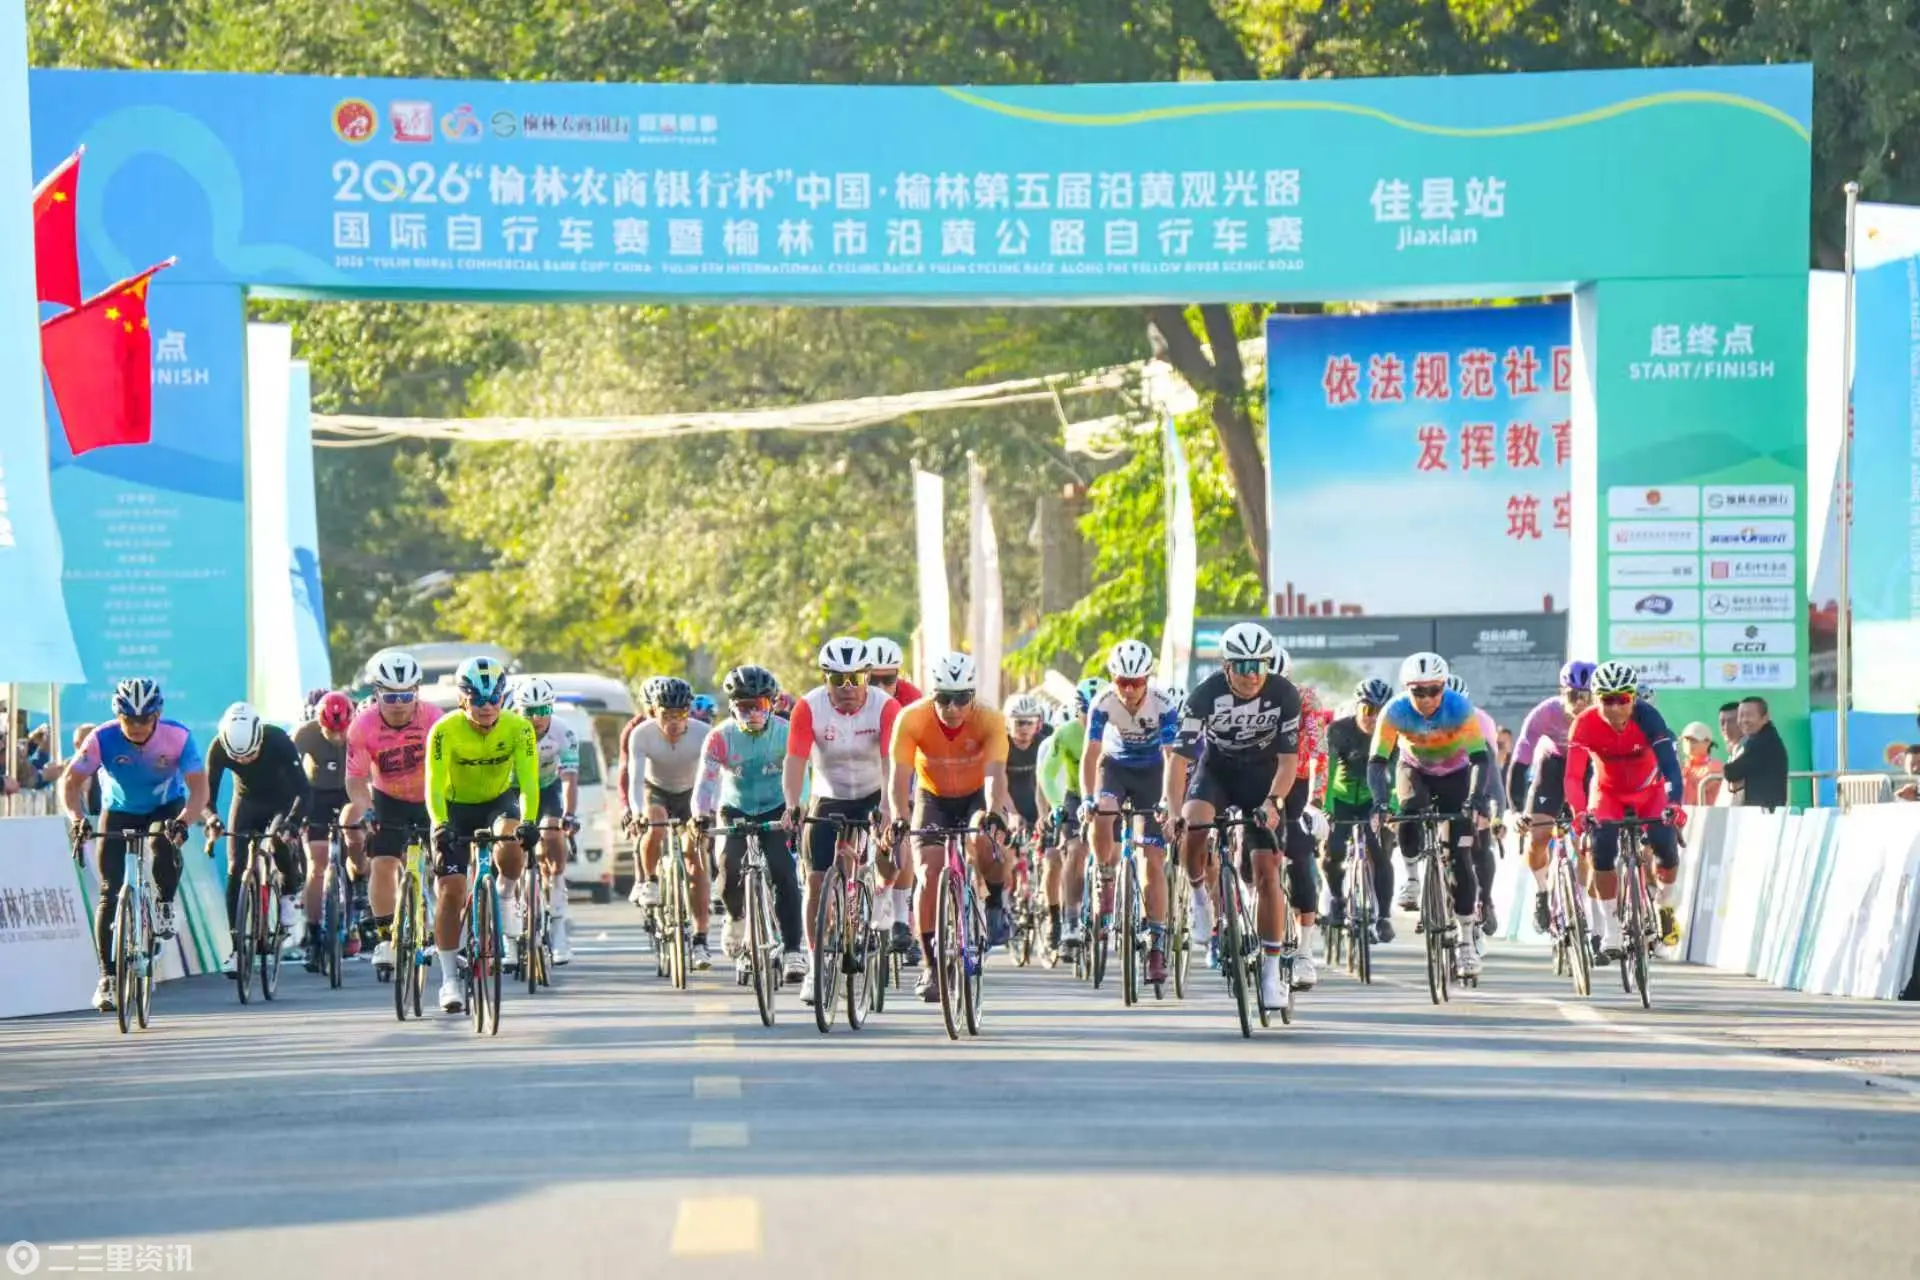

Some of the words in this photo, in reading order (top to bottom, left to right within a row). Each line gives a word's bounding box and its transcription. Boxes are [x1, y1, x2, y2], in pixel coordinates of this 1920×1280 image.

[1370, 176, 1506, 222] 佳县站
[1268, 259, 1304, 270] ROAD
[1650, 322, 1755, 357] 起终点
[1629, 359, 1776, 380] START/FINISH
